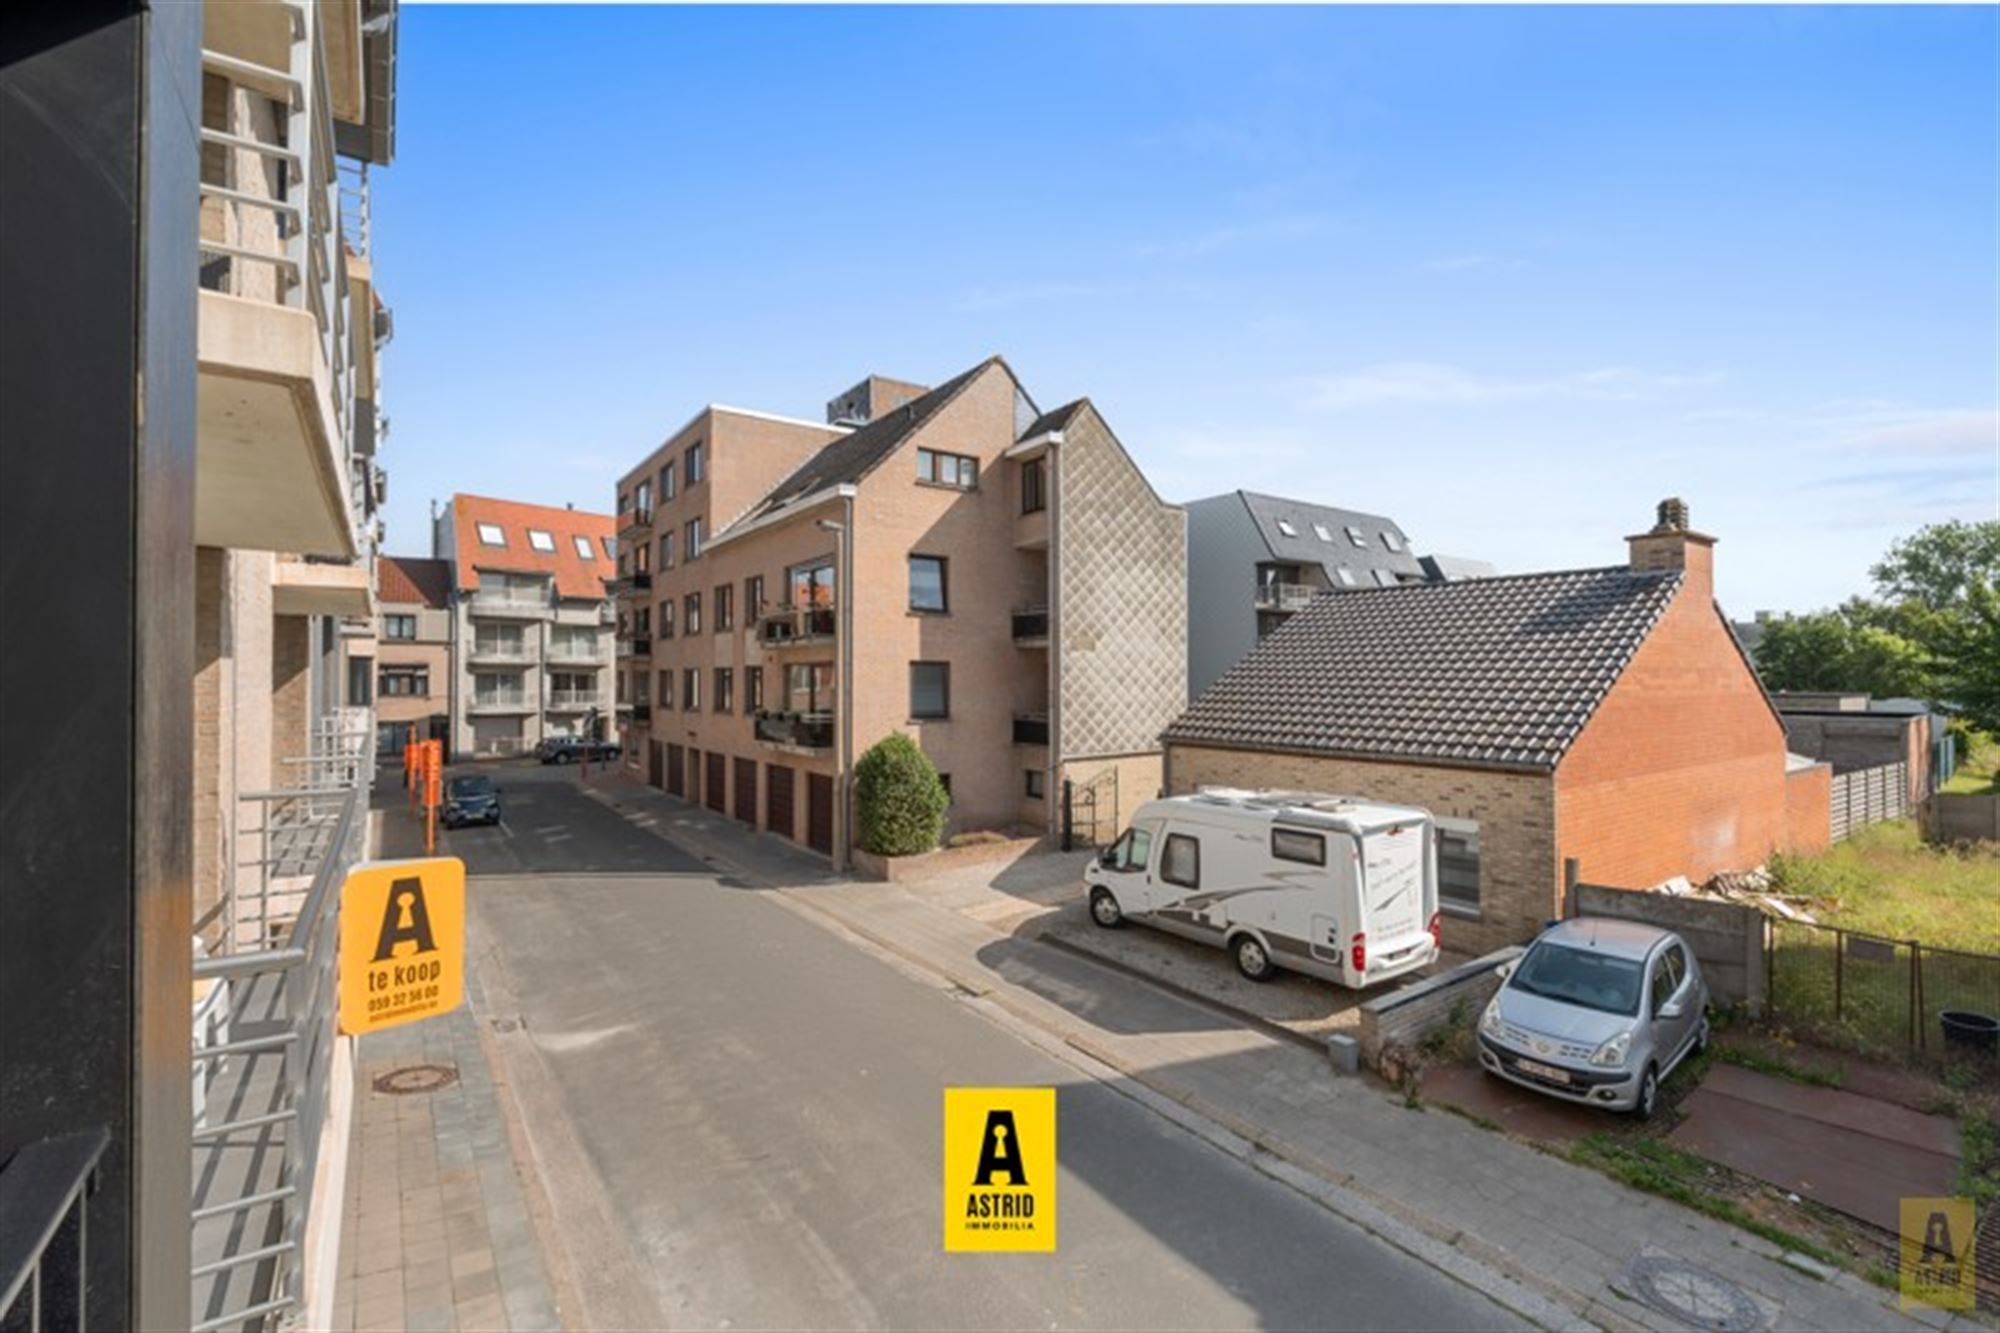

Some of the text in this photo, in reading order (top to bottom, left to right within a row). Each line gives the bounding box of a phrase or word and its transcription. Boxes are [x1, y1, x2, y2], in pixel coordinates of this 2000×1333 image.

[369, 876, 438, 963] A
[368, 959, 441, 992] te koop
[368, 995, 390, 1012] 059
